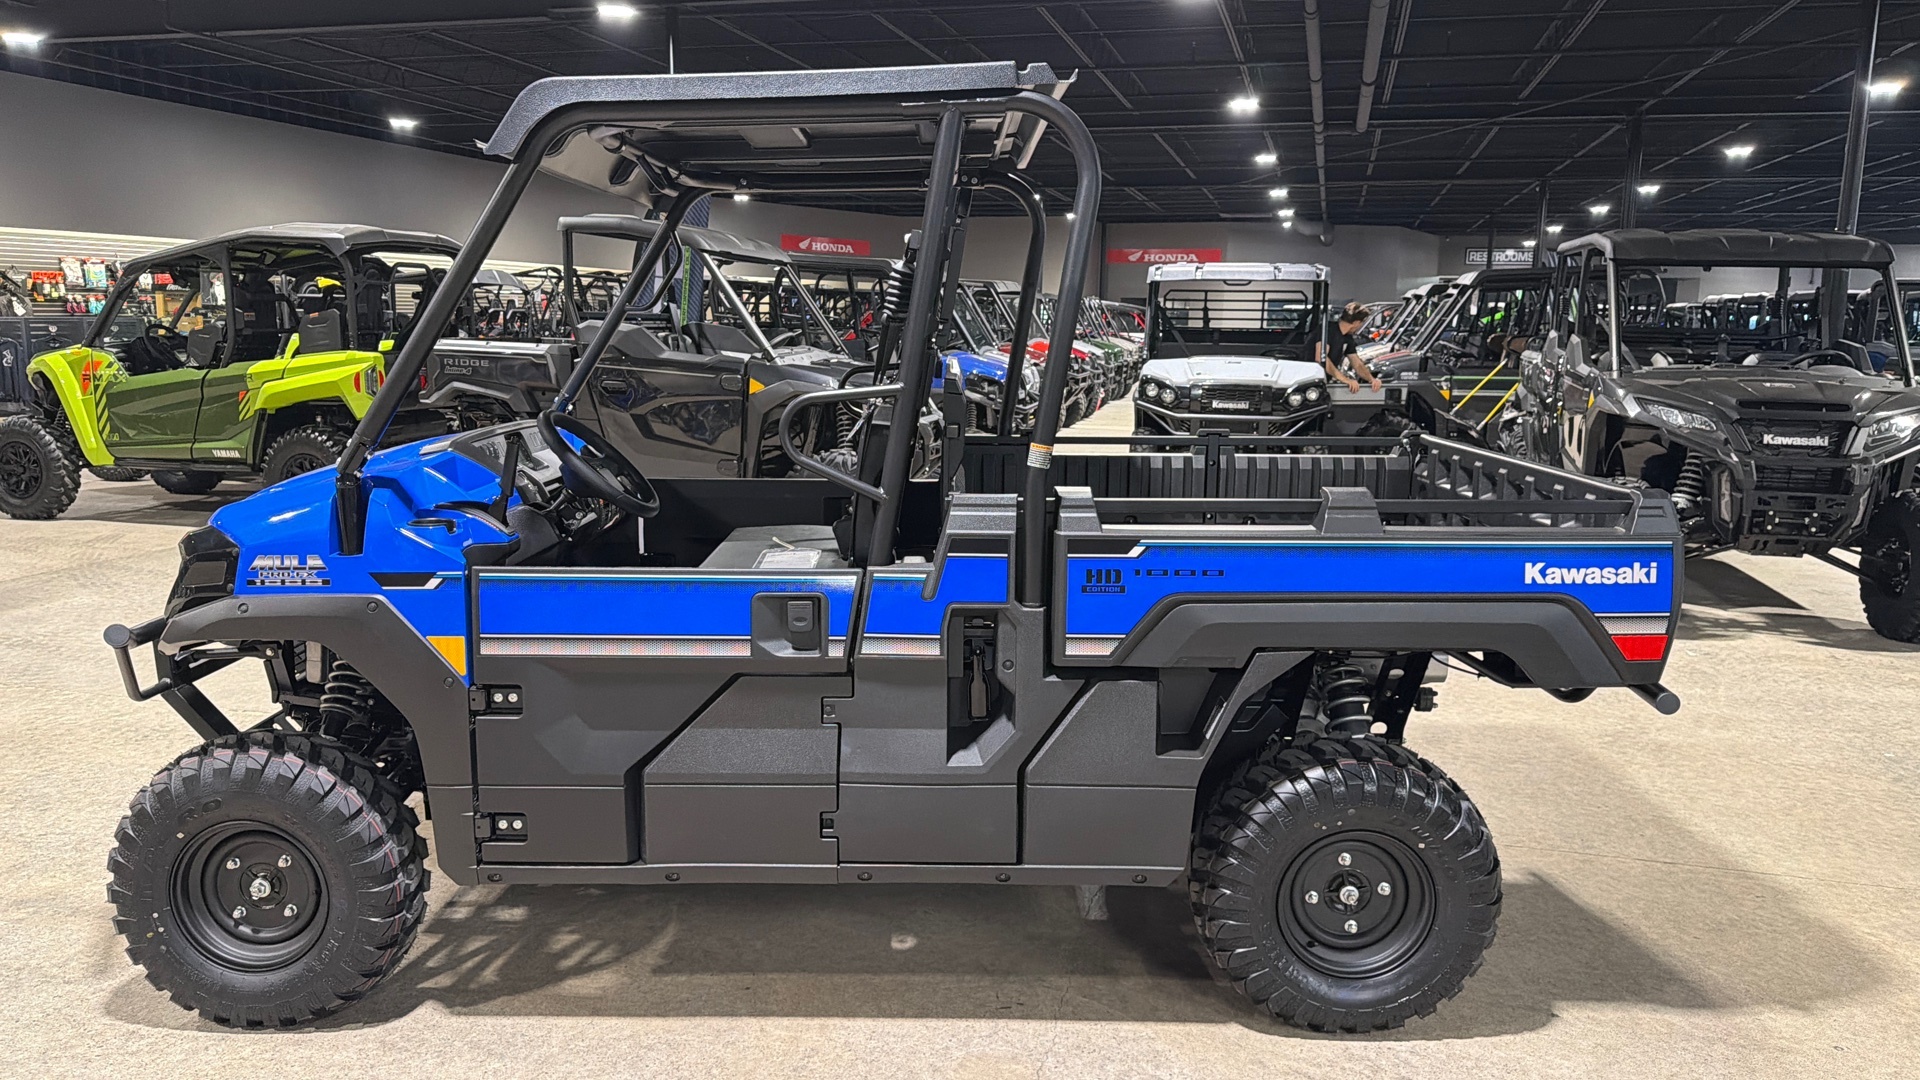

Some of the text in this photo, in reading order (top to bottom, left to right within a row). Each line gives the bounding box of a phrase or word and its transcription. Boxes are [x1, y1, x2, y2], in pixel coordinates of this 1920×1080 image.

[811, 242, 854, 253] HONDA
[1143, 253, 1199, 262] HONDA
[444, 358, 490, 367] RIDGE
[1212, 400, 1250, 409] Kawasaki
[1763, 433, 1829, 446] Kawasaki
[211, 449, 241, 458] YAMAHA
[248, 554, 329, 571] MULE
[1085, 568, 1122, 585] HD
[1524, 561, 1658, 585] Kawasaki
